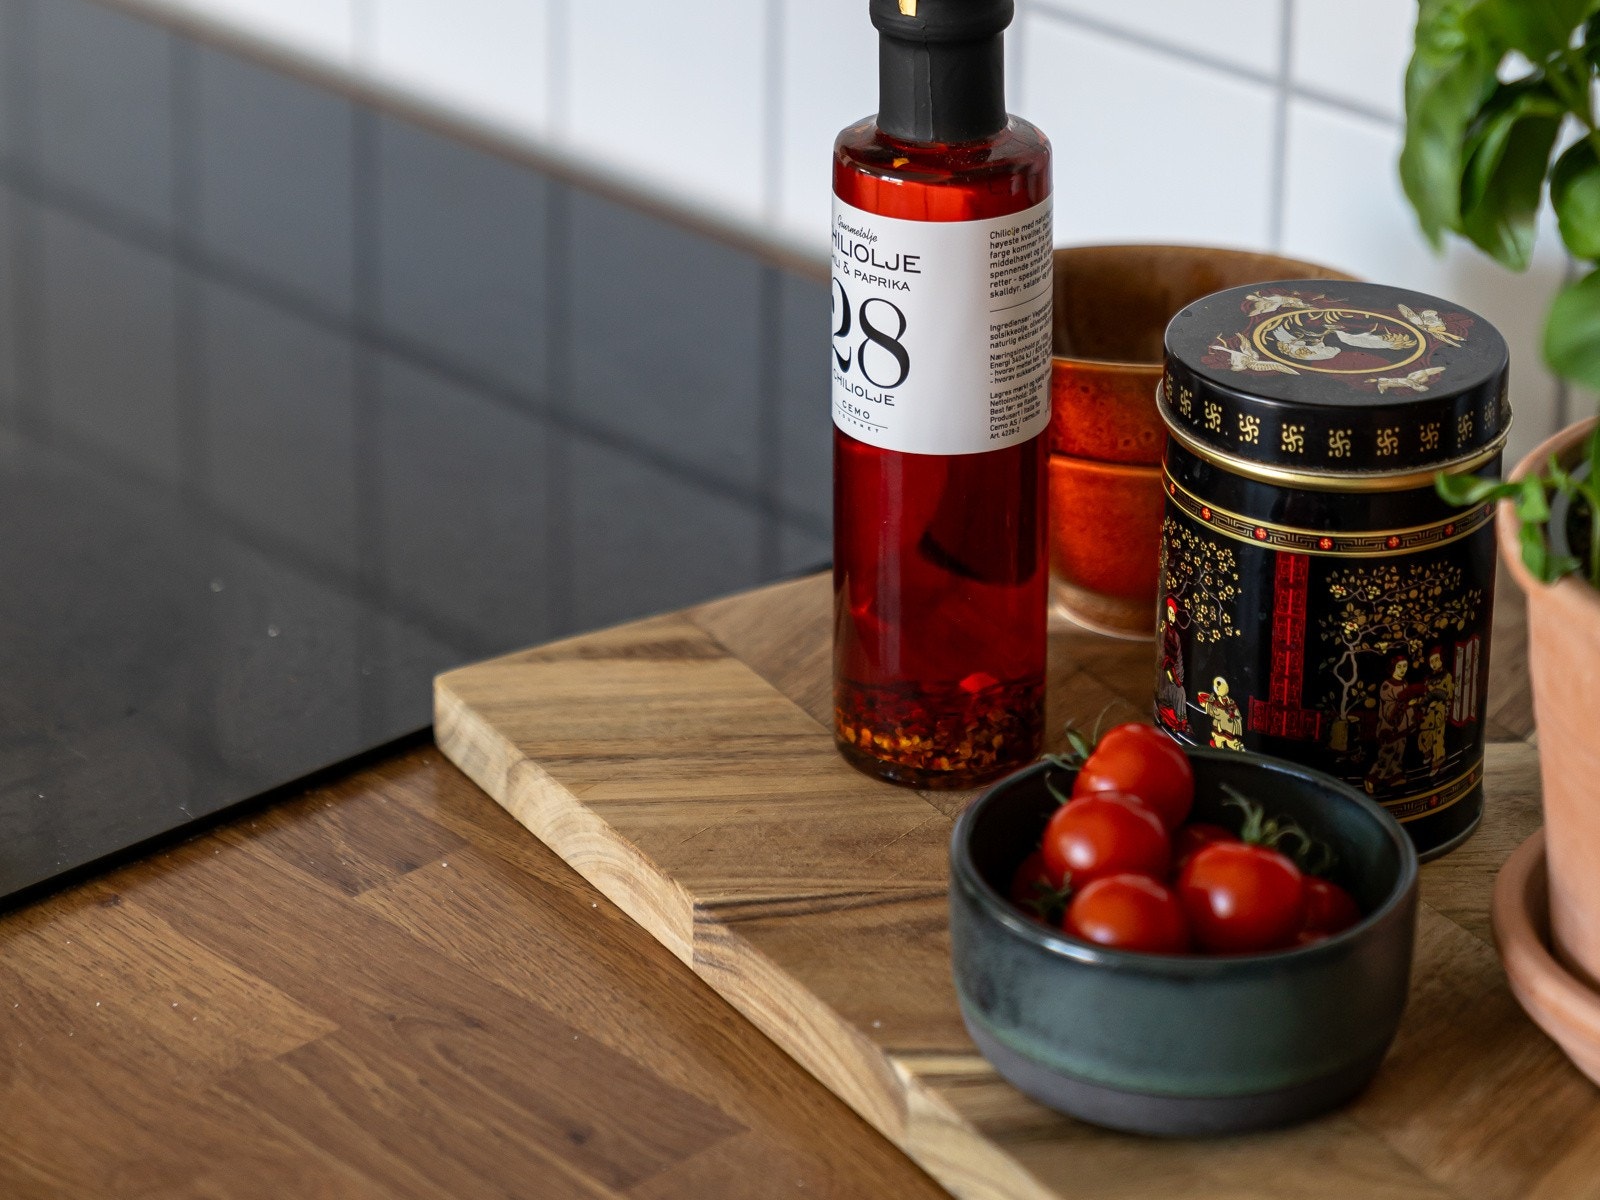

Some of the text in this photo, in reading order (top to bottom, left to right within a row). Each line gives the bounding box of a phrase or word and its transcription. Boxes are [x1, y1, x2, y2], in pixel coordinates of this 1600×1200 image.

[832, 229, 922, 274] HILIOLJE
[990, 237, 1020, 250] høyeste
[990, 249, 1011, 260] farge
[843, 260, 851, 276] &
[854, 269, 911, 292] PAPRIKA
[990, 278, 1013, 289] retter
[832, 276, 911, 390] 28
[833, 368, 896, 407] CHILIOLJE
[842, 400, 871, 420] CEMO
[990, 422, 1008, 432] Cemo
